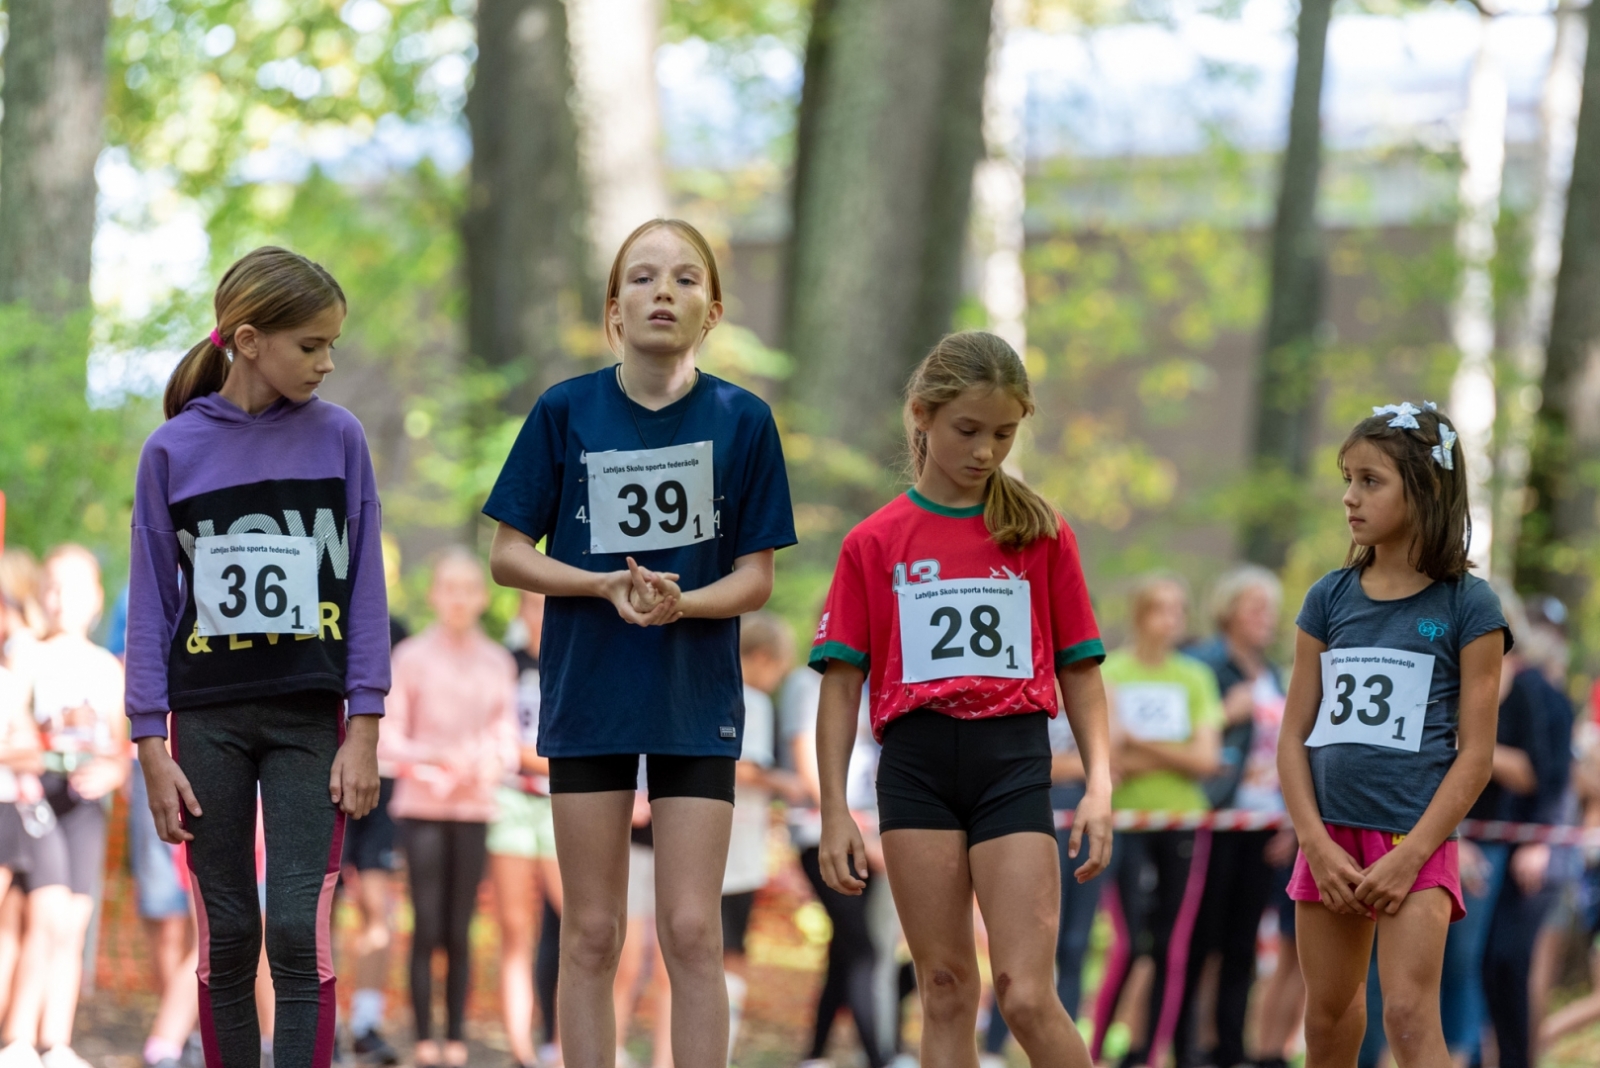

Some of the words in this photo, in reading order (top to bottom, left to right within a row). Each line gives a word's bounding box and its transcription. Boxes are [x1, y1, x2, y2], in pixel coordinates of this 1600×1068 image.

[603, 465, 625, 474] Latvijas
[645, 462, 666, 472] sporta
[617, 480, 688, 537] 39
[693, 514, 703, 539] 1
[230, 545, 245, 553] Skolu
[246, 545, 268, 554] sporta
[218, 564, 288, 618] 36
[291, 605, 304, 629] 1
[915, 590, 939, 600] Latvijas
[939, 587, 959, 596] Skolu
[960, 586, 981, 595] sporta
[929, 604, 1003, 661] 28
[1005, 645, 1019, 669] 1
[1361, 656, 1381, 664] sporta
[1330, 673, 1394, 726] 33
[1391, 716, 1406, 741] 1
